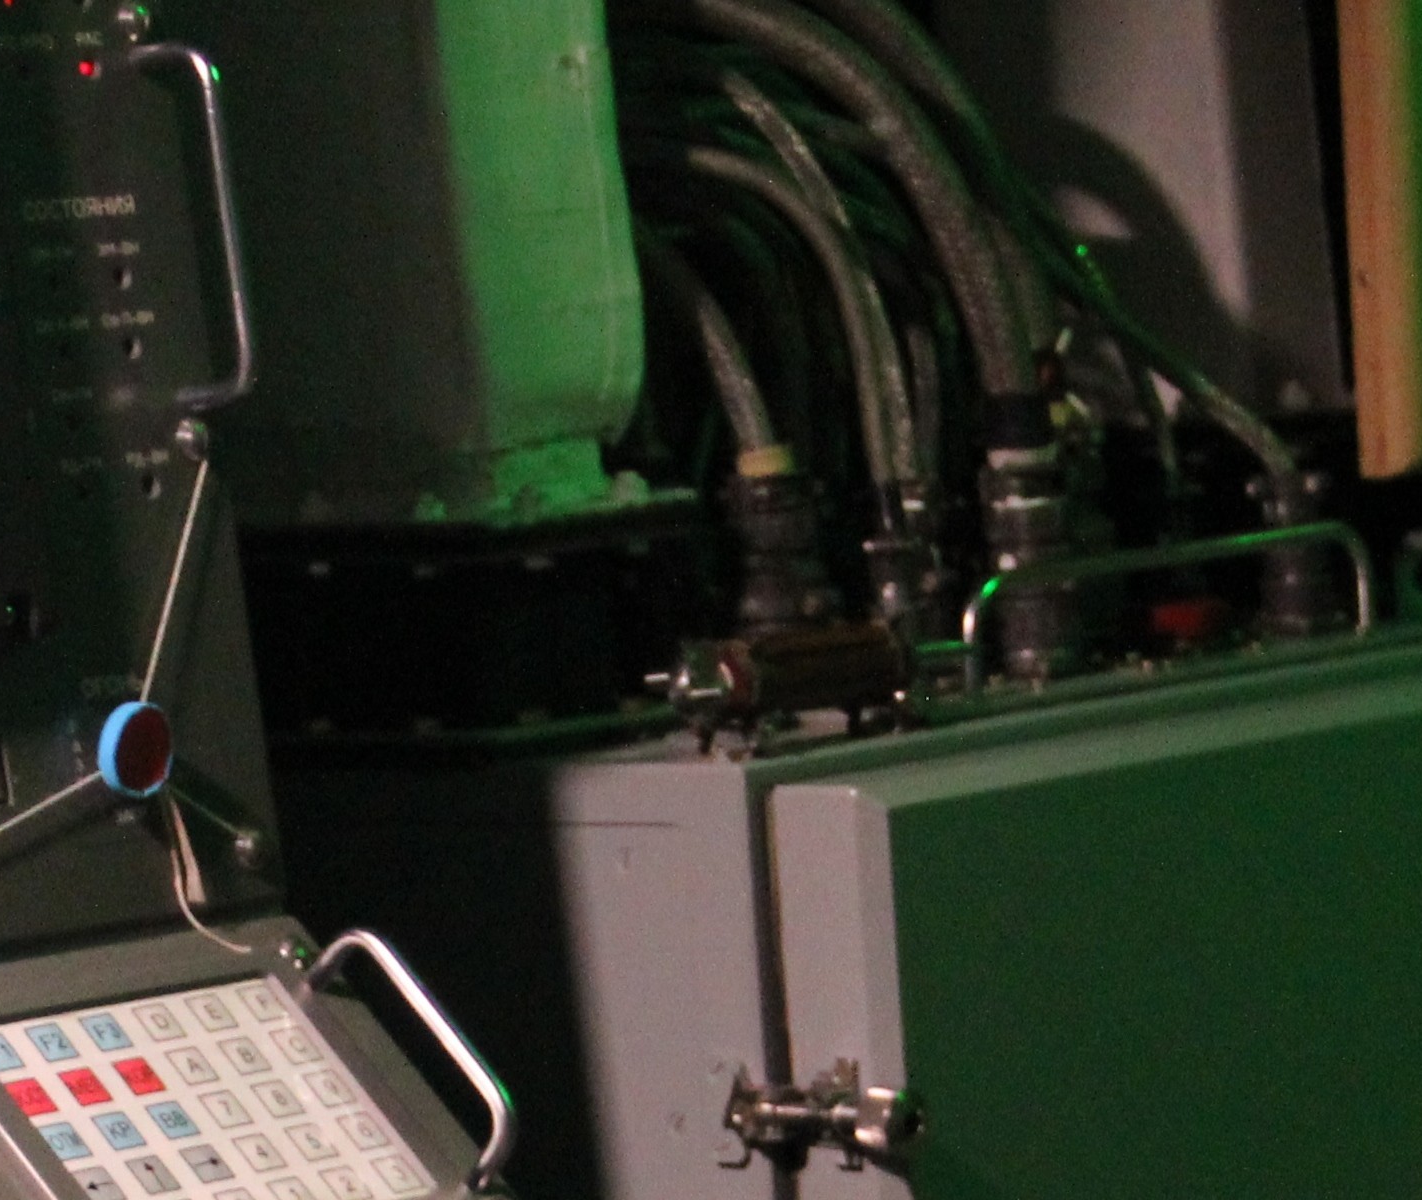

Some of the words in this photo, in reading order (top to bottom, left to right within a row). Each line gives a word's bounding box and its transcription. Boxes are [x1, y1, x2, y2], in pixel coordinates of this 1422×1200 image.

[38, 1032, 68, 1051] F2
[93, 1022, 122, 1040] F3
[186, 1057, 204, 1073] A
[254, 1144, 269, 1160] 4
[339, 1176, 357, 1193] 2
